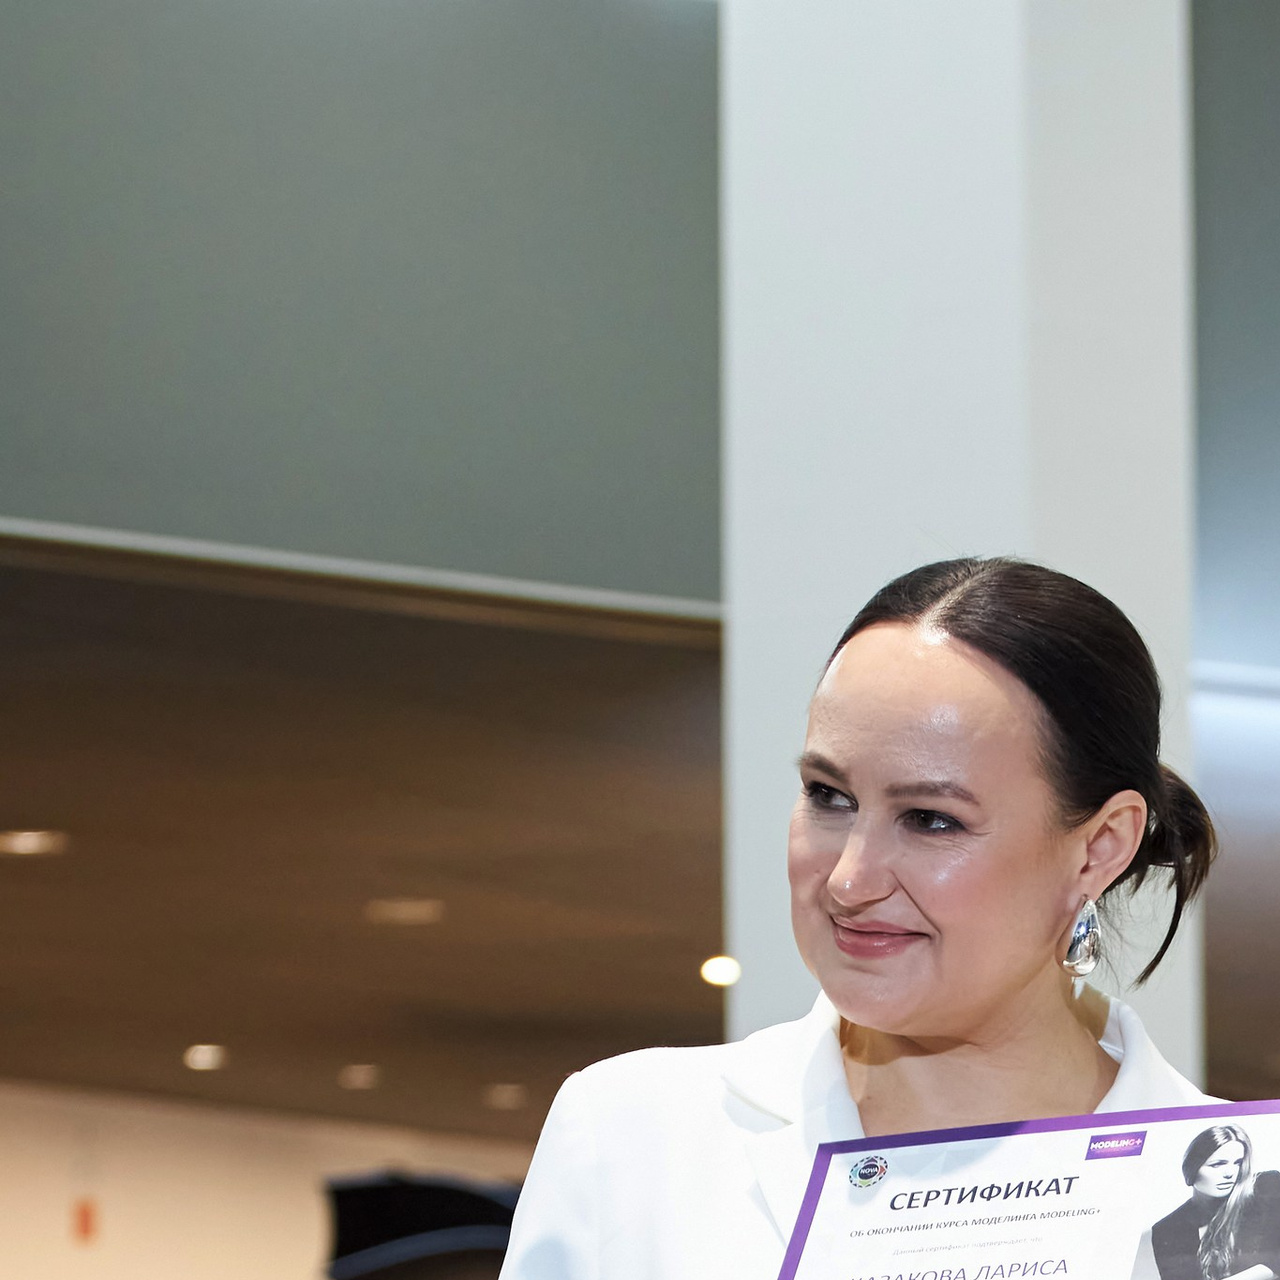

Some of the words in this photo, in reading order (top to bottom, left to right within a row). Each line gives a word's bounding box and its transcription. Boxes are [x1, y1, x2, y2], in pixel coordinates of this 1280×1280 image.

[860, 1167, 878, 1175] NOVA
[889, 1176, 1080, 1211] СЕРТИФИКАТ
[849, 1230, 865, 1238] ОБ
[866, 1223, 934, 1237] ОКОНЧАНИИ
[935, 1219, 968, 1230] КУРСА
[970, 1213, 1037, 1226] МОДЕЛИНГА
[1039, 1207, 1101, 1219] MODELING+
[925, 1243, 969, 1253] сертификат
